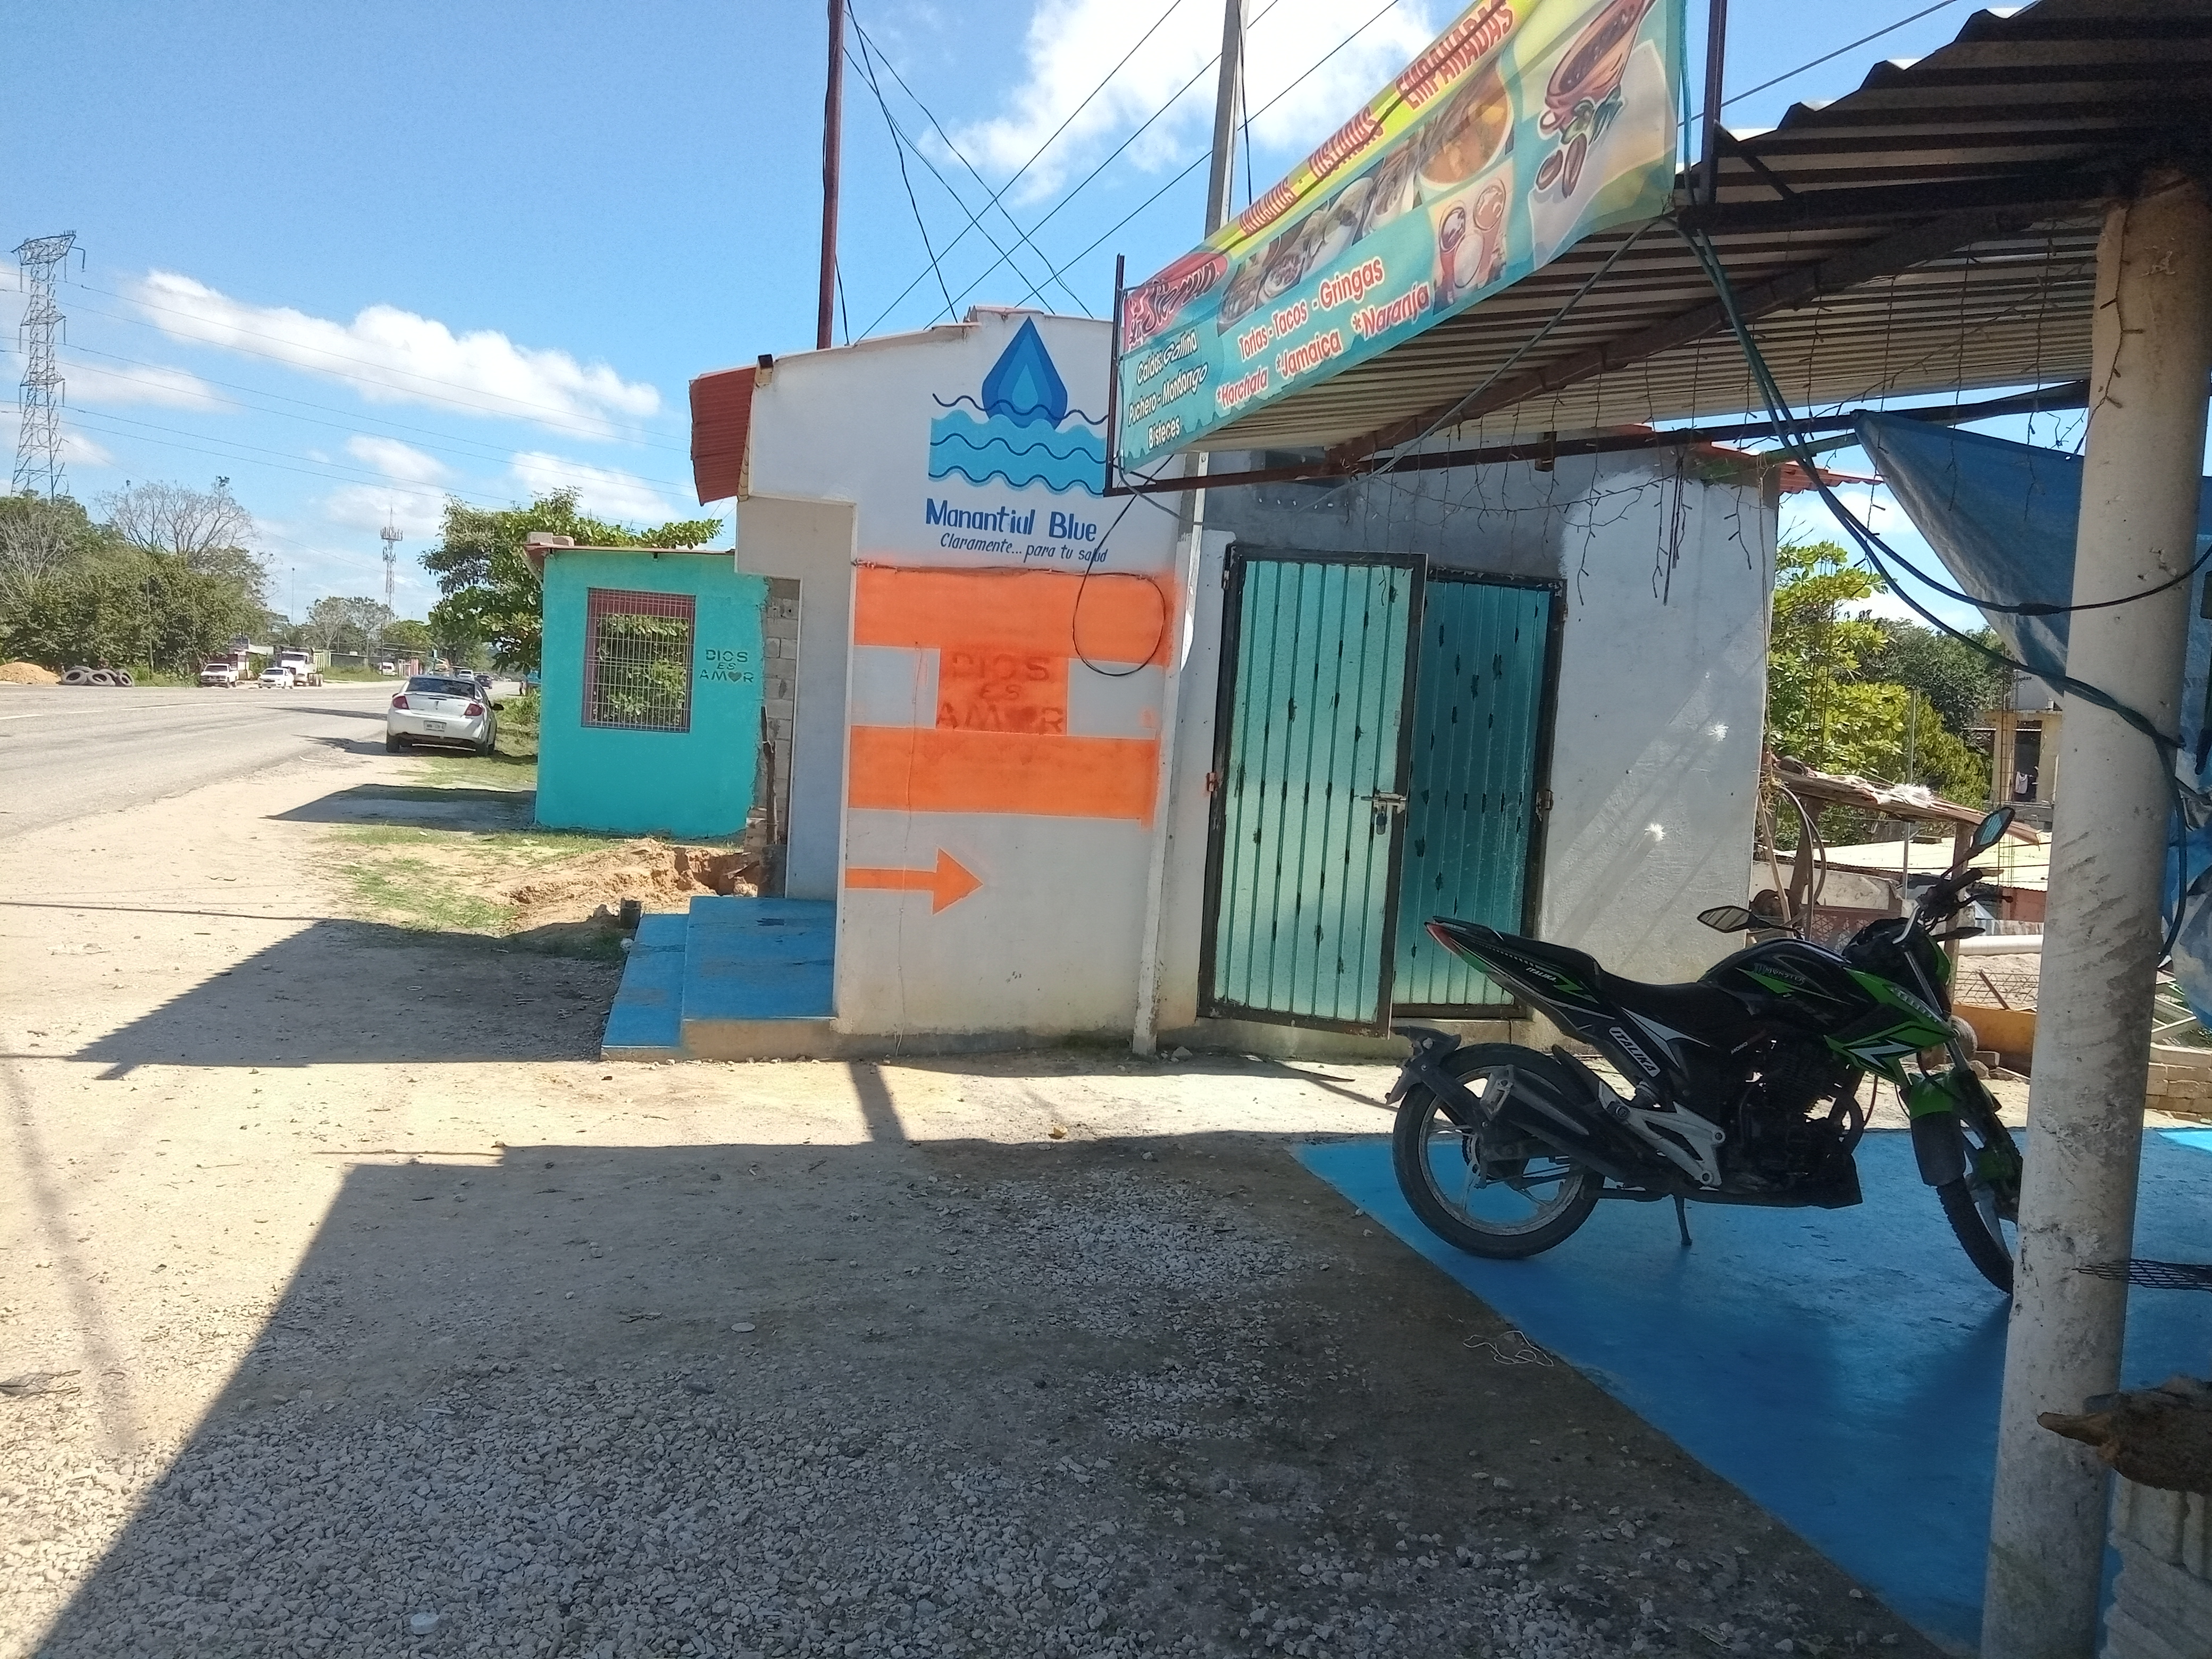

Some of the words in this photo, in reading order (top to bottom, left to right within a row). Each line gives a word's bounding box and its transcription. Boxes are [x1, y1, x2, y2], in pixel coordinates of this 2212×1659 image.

[1395, 0, 1513, 110] EMPANADAS
[1239, 325, 1268, 361] Tortas
[1273, 301, 1307, 339] Tacos
[1320, 257, 1384, 311] Gringas
[1162, 330, 1197, 366] Gallina
[1128, 391, 1157, 427] Puchero
[1162, 362, 1208, 407] Mondongo
[1148, 415, 1180, 450] Bisteces
[1049, 511, 1097, 542] Blue
[1023, 543, 1056, 564] para
[1060, 544, 1074, 559] tu
[1078, 547, 1108, 563] salud
[706, 649, 748, 663] DIOS
[952, 651, 1050, 681] DIOS
[1525, 967, 1556, 982] ITALIKA
[1611, 1029, 1657, 1071] ITALIKA
